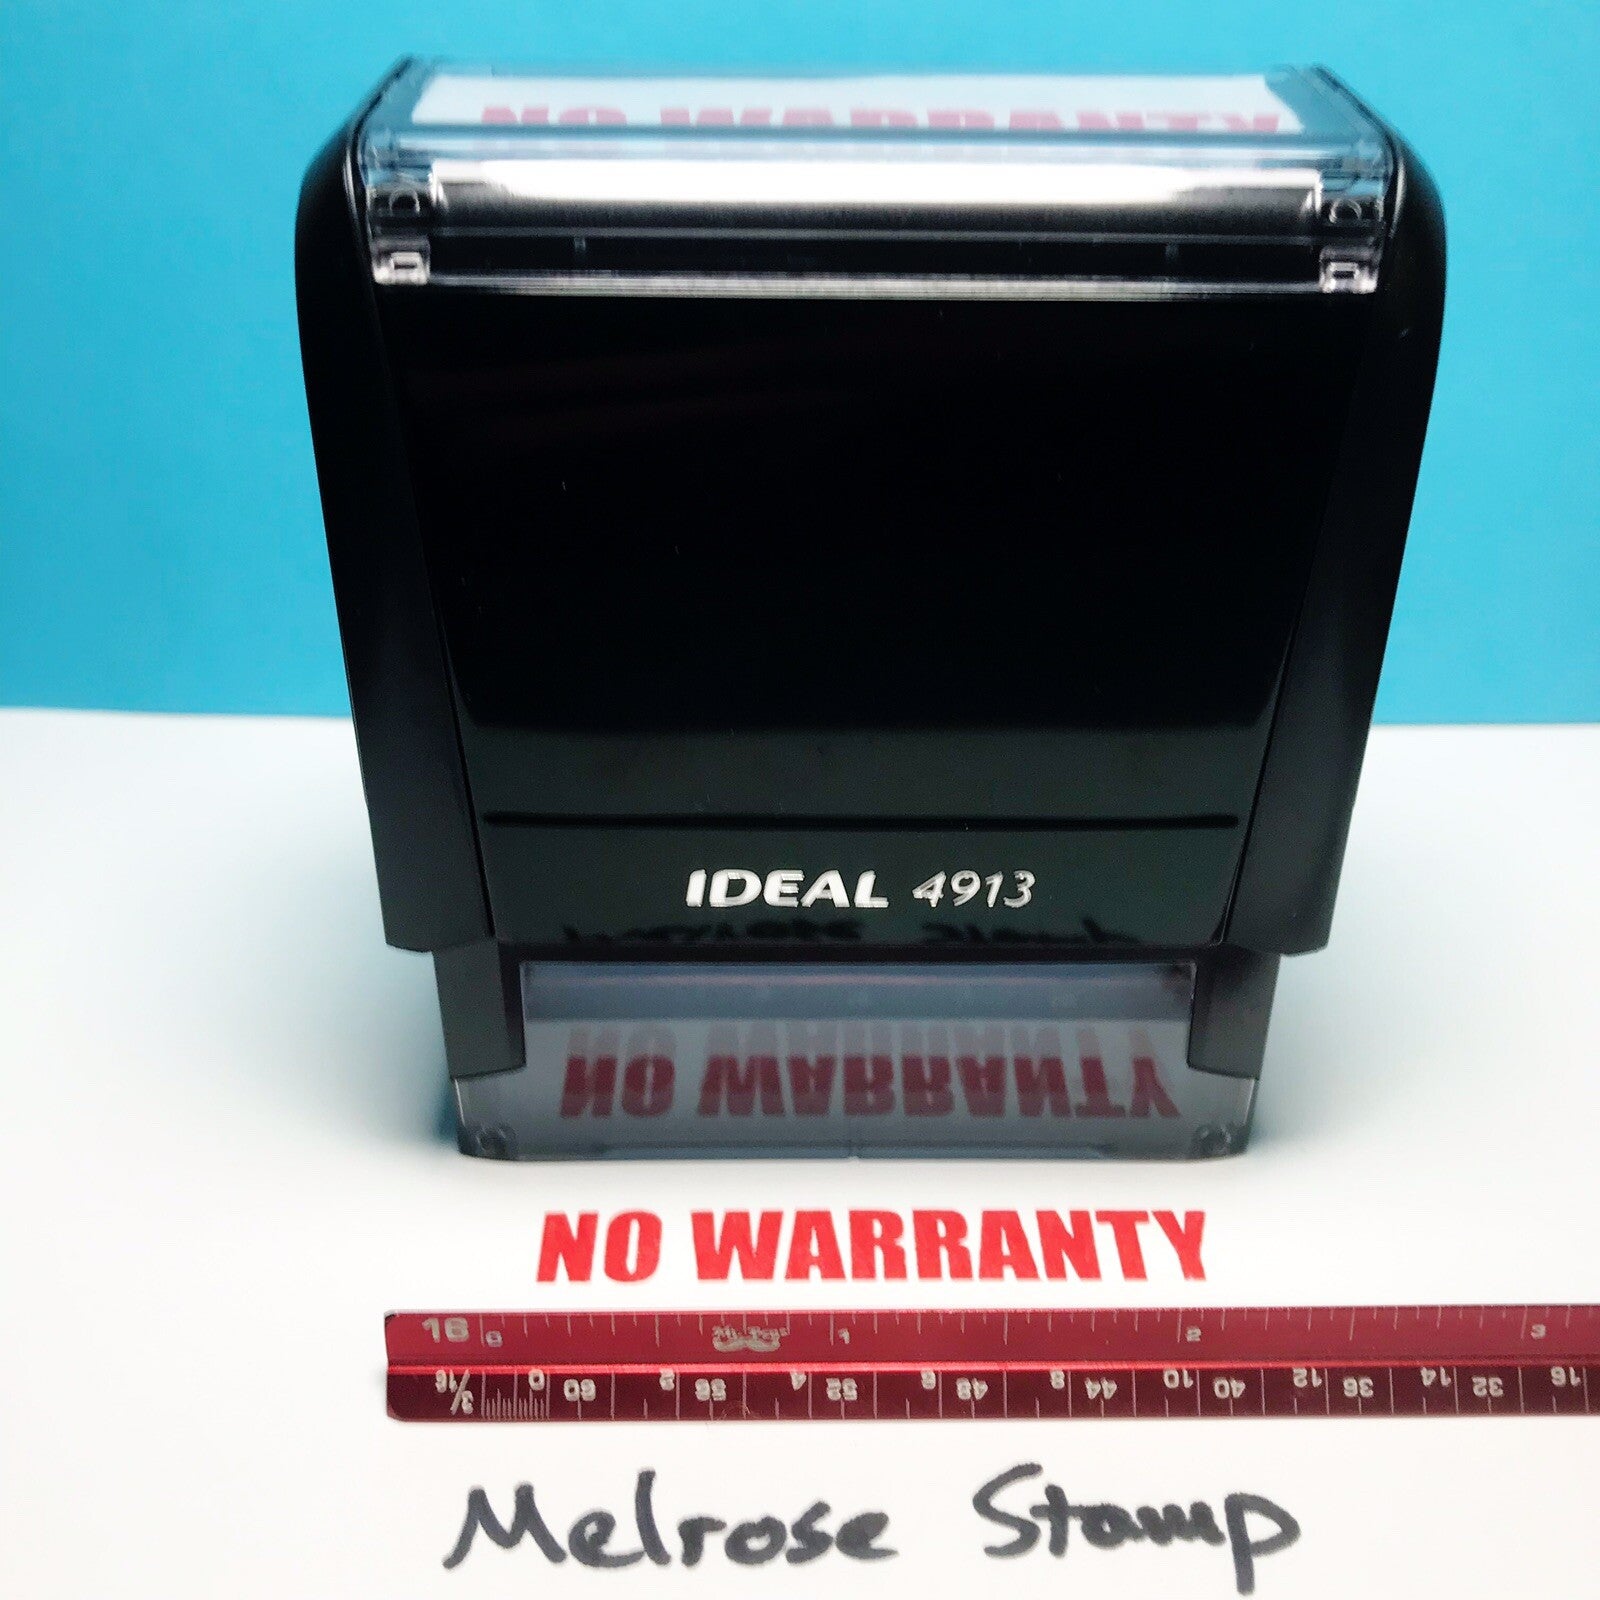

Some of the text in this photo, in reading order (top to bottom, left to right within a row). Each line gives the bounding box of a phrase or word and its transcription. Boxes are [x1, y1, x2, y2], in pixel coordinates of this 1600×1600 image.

[686, 869, 1036, 908] IDEAL 4913
[537, 1209, 1207, 1283] NO WARRANTY
[422, 1317, 469, 1343] 16
[528, 1368, 545, 1391] 0
[1163, 1368, 1193, 1389] 10
[1293, 1367, 1323, 1388] 12
[1343, 1376, 1374, 1398] 36
[1420, 1366, 1452, 1387] 14
[1472, 1376, 1504, 1398] 32
[1550, 1366, 1581, 1388] 16
[563, 1378, 596, 1401] 60
[1085, 1377, 1117, 1399] 44
[1214, 1377, 1246, 1399] 40
[443, 1463, 1302, 1596] Melrose Stamp
